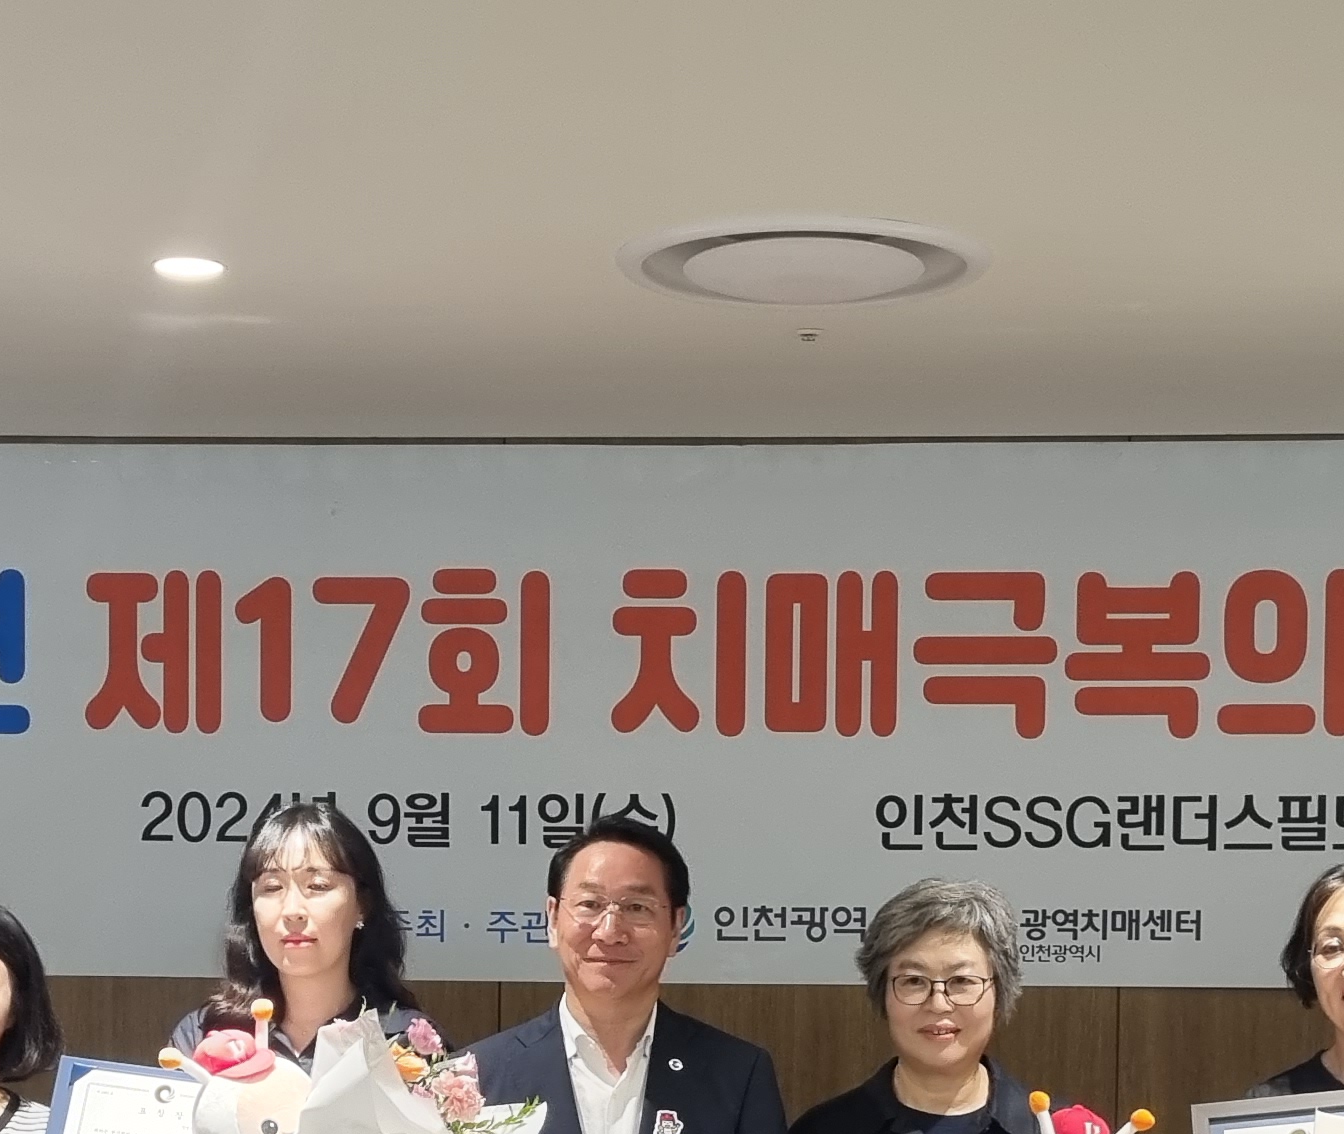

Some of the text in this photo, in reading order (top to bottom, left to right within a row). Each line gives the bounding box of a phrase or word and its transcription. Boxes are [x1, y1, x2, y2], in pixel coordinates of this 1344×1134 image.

[85, 569, 550, 736] 제17회
[140, 790, 337, 842] 202
[367, 791, 451, 848] 9월
[486, 911, 549, 943] 주관
[714, 905, 867, 943] 인천광역
[1019, 908, 1202, 941] 광역치매센터
[1019, 943, 1101, 963] 인천광역시
